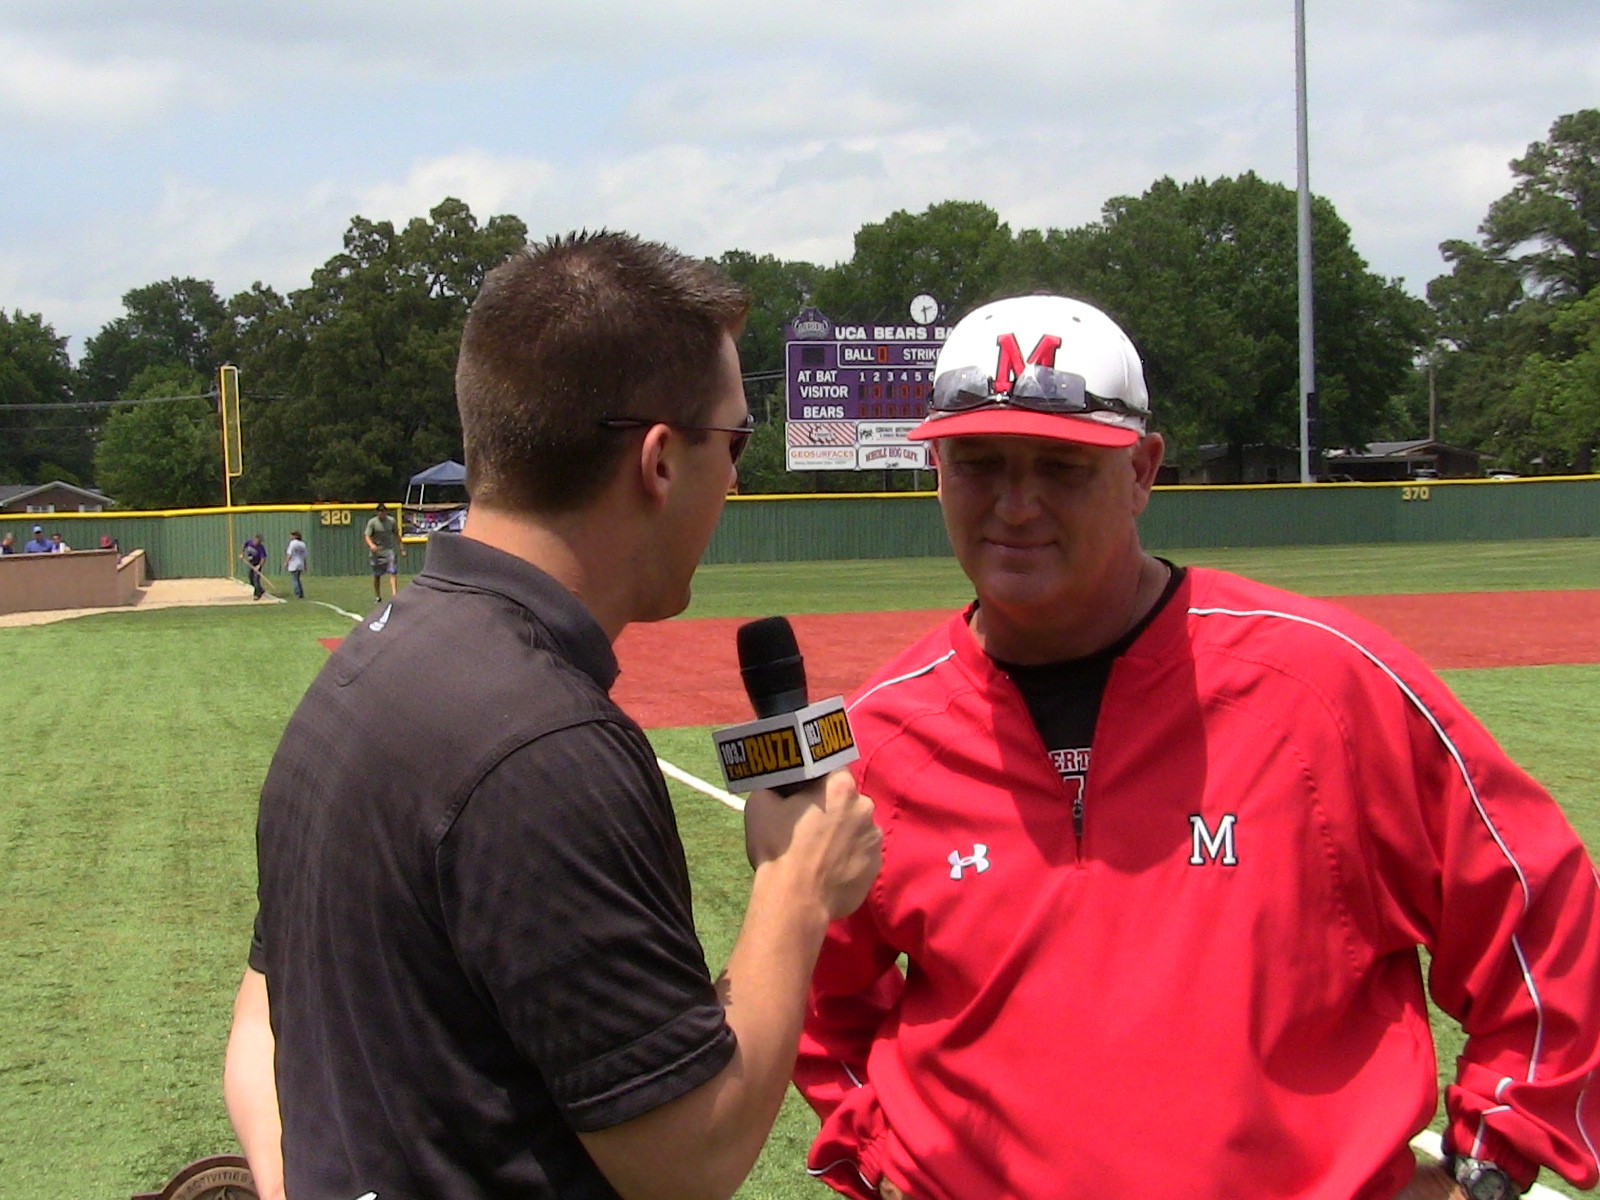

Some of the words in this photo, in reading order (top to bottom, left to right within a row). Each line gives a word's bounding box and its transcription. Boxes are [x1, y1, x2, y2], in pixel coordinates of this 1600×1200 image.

[834, 326, 867, 340] UCA
[873, 326, 928, 340] BEARS
[844, 348, 875, 361] BALL
[993, 332, 1062, 393] M
[798, 370, 811, 383] AT
[816, 370, 838, 383] BAT
[859, 371, 866, 382] 1
[873, 371, 880, 382] 2
[887, 371, 894, 382] 3
[900, 371, 908, 382] 4
[914, 371, 922, 382] 5
[799, 385, 849, 398] VISITOR
[803, 406, 845, 419] BEARS
[791, 450, 854, 459] GEOSURFACES
[1402, 486, 1430, 500] 370
[321, 510, 351, 525] 320
[817, 711, 853, 754] BUZZ
[720, 740, 747, 766] 103.7
[744, 729, 802, 774] BUZZ
[1188, 813, 1238, 866] M
[187, 1171, 248, 1192] ACTIVITIES
